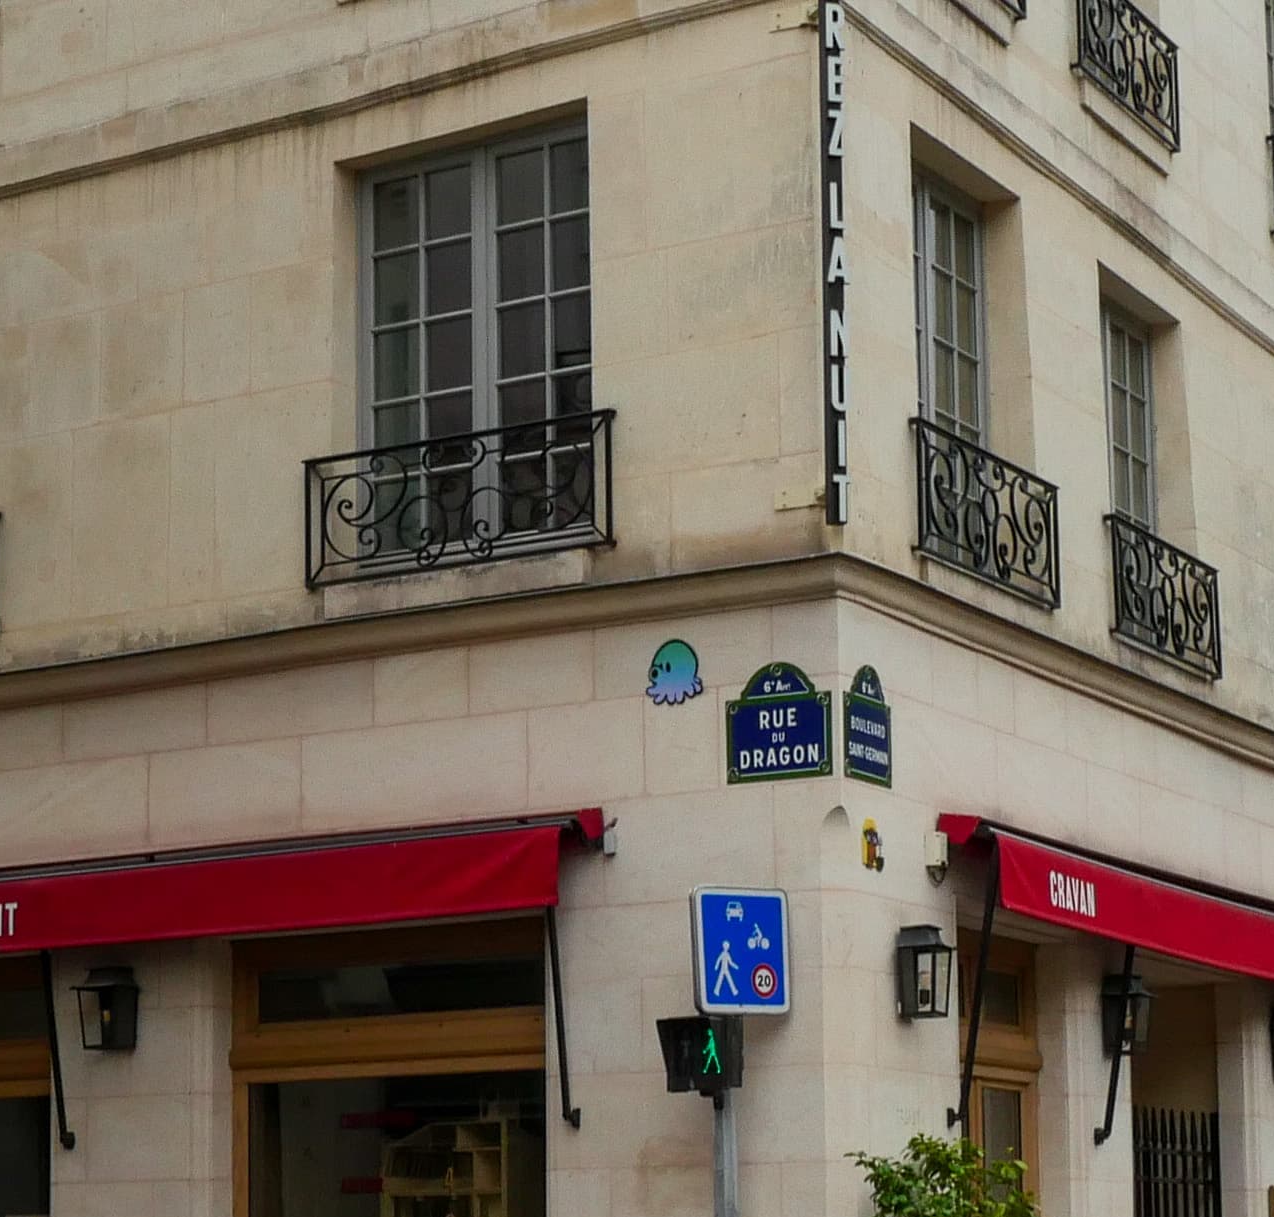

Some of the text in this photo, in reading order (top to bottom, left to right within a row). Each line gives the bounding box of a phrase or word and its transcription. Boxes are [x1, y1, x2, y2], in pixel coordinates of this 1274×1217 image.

[827, 181, 849, 283] LA
[829, 309, 852, 523] NUIT
[759, 707, 798, 730] RUE
[850, 715, 886, 739] BOULEVARD
[772, 732, 786, 743] DU
[740, 743, 820, 770] DRAGON
[1049, 869, 1096, 918] CRAVAN
[757, 974, 771, 988] 20
